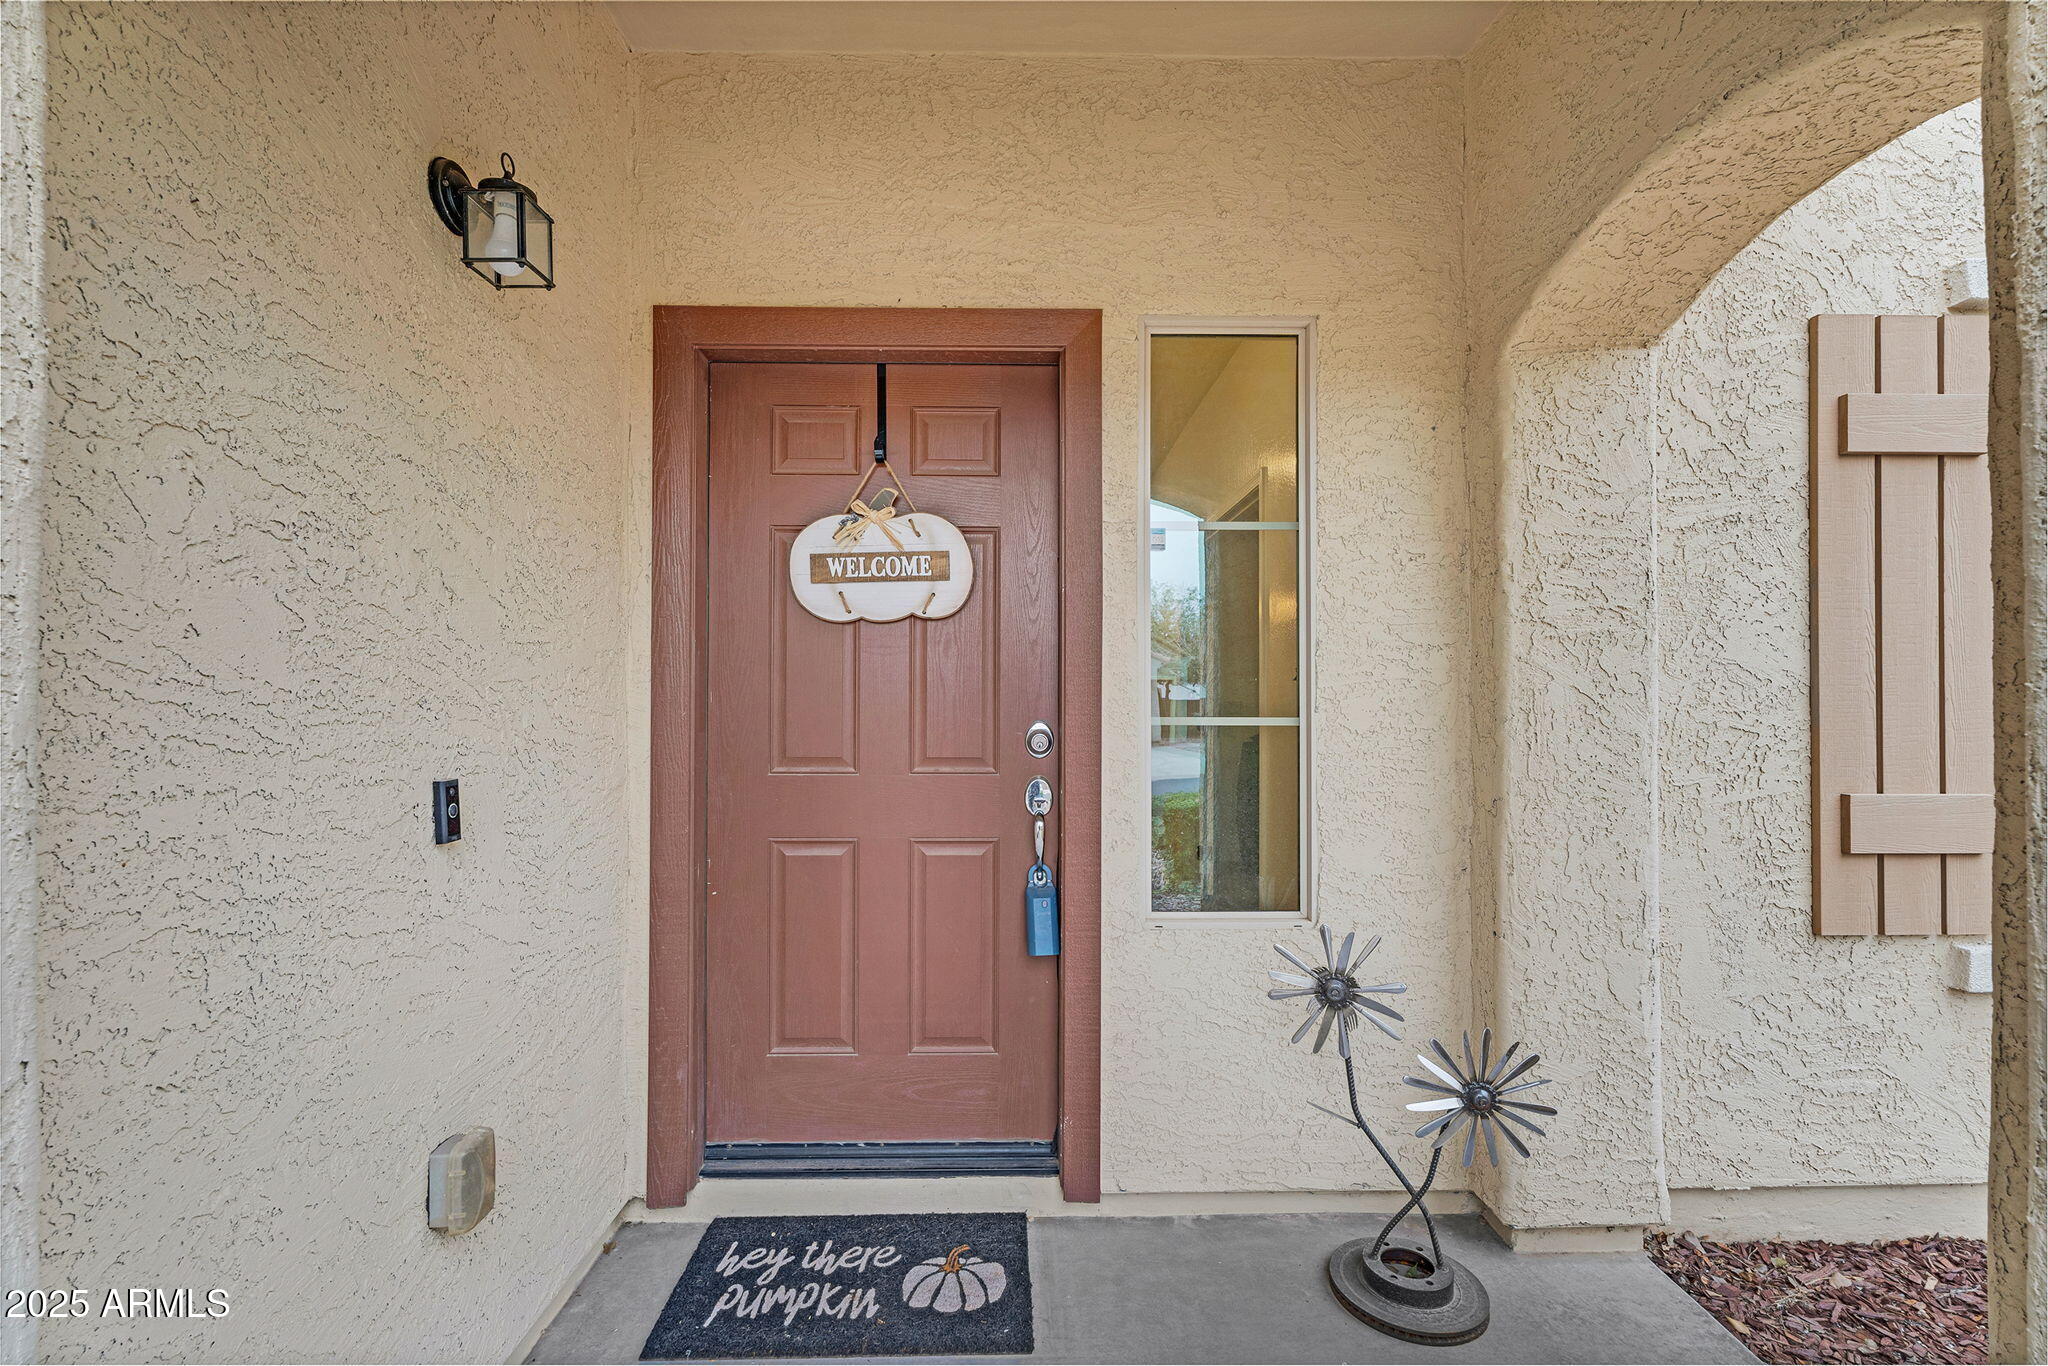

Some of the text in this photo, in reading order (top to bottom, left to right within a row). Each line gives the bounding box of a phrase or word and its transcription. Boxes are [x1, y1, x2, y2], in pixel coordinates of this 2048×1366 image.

[827, 555, 932, 578] WELCOME
[716, 1240, 903, 1285] hey there
[702, 1282, 880, 1328] pumpkin
